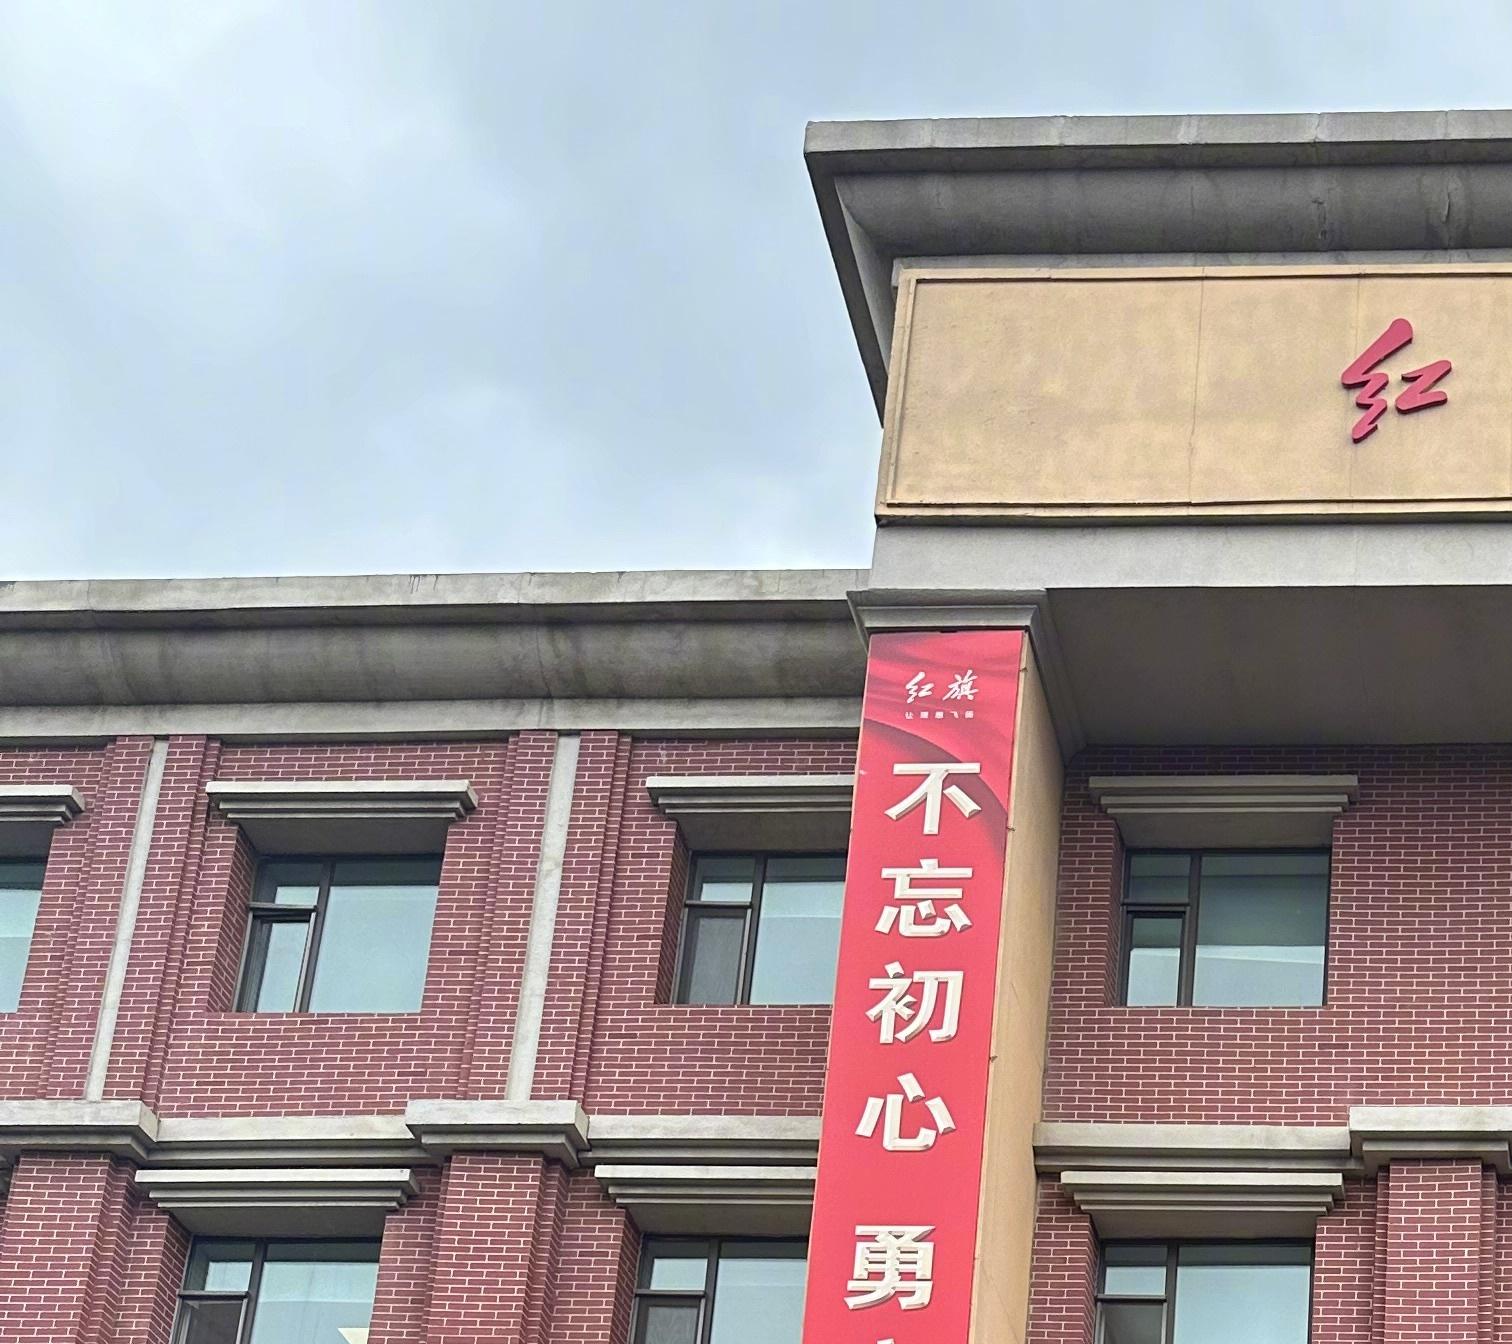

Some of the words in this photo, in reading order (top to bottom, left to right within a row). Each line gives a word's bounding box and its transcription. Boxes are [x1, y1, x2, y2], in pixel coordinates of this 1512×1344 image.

[904, 669, 979, 704] 红旗
[854, 760, 983, 1153] 不忘初心
